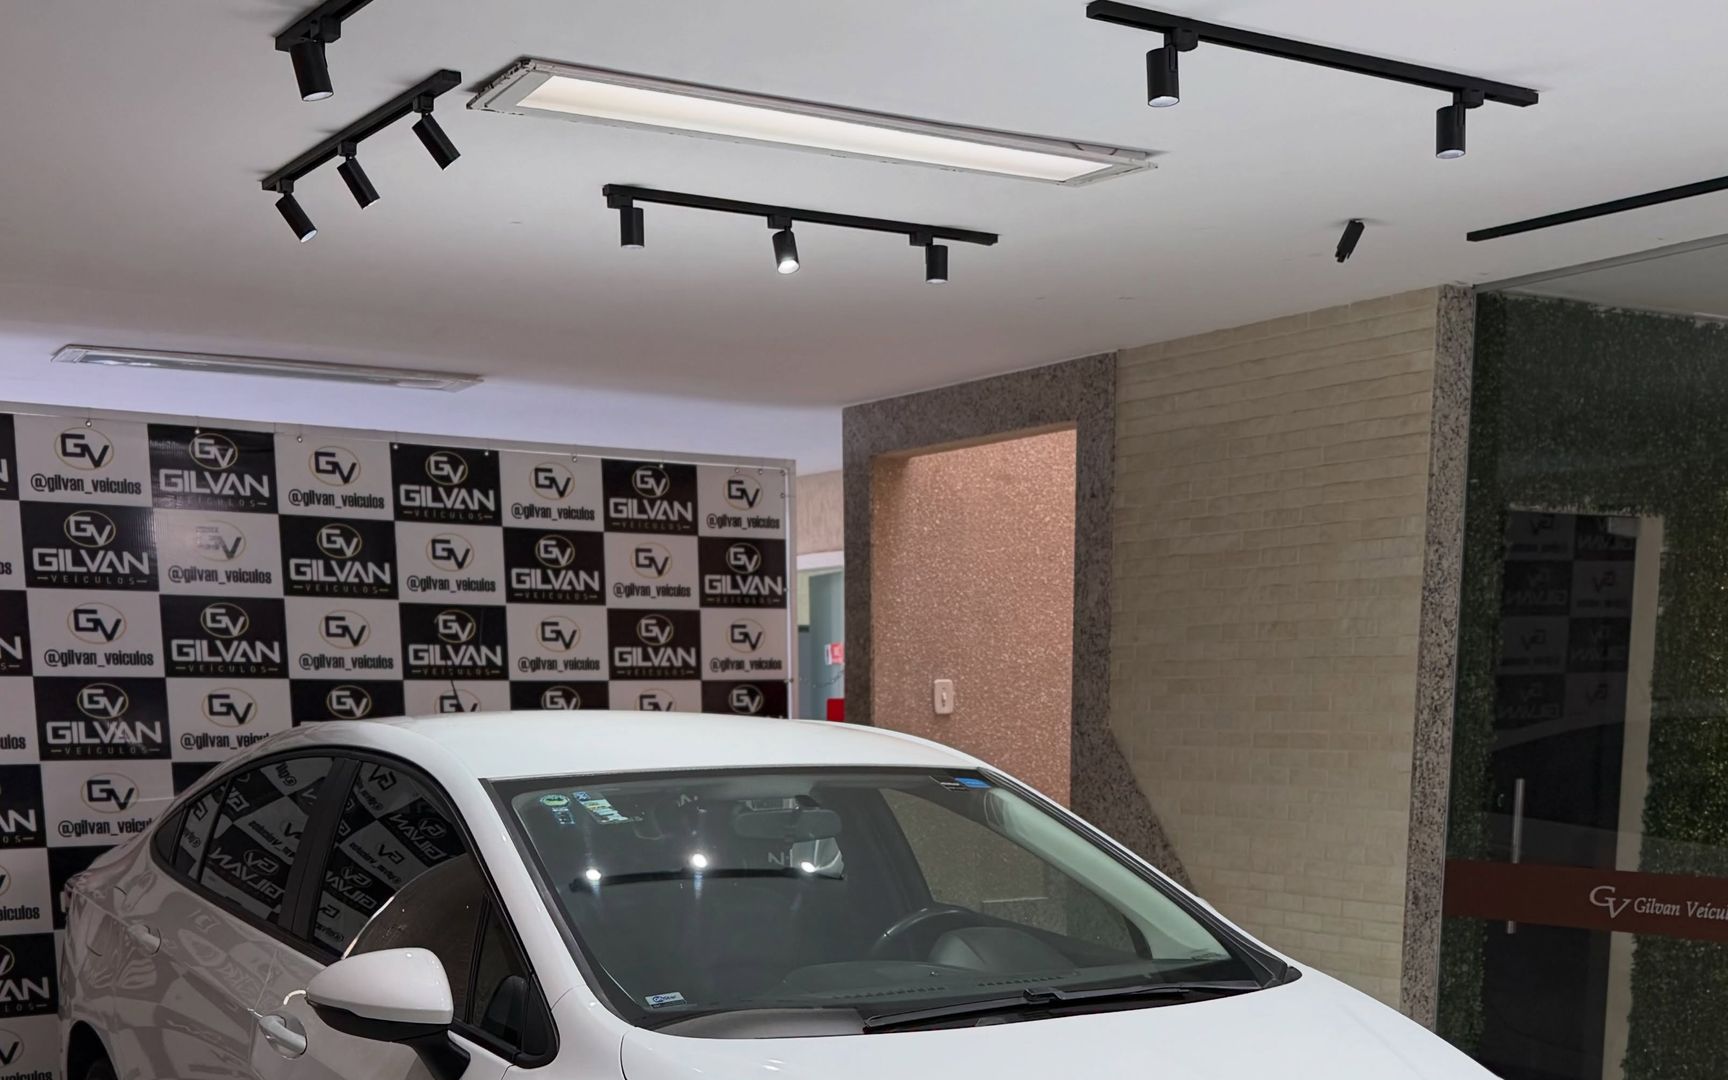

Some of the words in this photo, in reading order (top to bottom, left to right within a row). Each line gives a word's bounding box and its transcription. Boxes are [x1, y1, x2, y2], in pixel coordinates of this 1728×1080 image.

[61, 434, 109, 468] GV
[194, 438, 234, 468] GV
[314, 451, 356, 484] GV
[430, 456, 464, 484] GV
[30, 473, 142, 496] @gilvan_veiculos
[159, 468, 270, 498] GILVAN
[535, 467, 572, 498] GV
[636, 470, 666, 496] GV
[728, 480, 760, 508] GV
[288, 488, 384, 510] @gilvan_veiculos
[400, 484, 496, 512] GILVAN
[608, 497, 693, 522] GILVAN
[511, 504, 595, 522] @gilvan_veiculos
[706, 514, 780, 530] @gilvan_veiculos
[69, 516, 112, 546] GV
[321, 528, 358, 557] GV
[32, 548, 150, 574] GILVAN
[431, 539, 470, 569] GV
[539, 540, 572, 566] GV
[634, 548, 668, 577] GV
[730, 550, 758, 573] GV
[168, 566, 272, 584] @gilvan_veiculos
[290, 558, 391, 584] GILVAN
[511, 568, 600, 591] GILVAN
[407, 576, 496, 594] @gilvan_veiculos
[613, 582, 691, 598] @gilvan_veiculos
[704, 574, 783, 596] GILVAN
[73, 608, 122, 641] GV
[206, 608, 244, 636] GV
[324, 616, 366, 646] GV
[438, 615, 472, 642] GV
[540, 621, 578, 649] GV
[640, 618, 671, 644] GV
[730, 624, 762, 650] GV
[44, 648, 154, 668] @gilvan_veiculos
[171, 638, 280, 664] GILVAN
[299, 654, 394, 672] @gilvan_veiculos
[408, 644, 502, 666] GILVAN
[614, 646, 696, 668] GILVAN
[518, 656, 600, 673] @gilvan_veiculos
[710, 658, 782, 673] @gilvan_veiculos
[81, 688, 124, 717] GV
[208, 694, 253, 724] GV
[332, 690, 368, 717] GV
[732, 690, 759, 714] GV
[46, 720, 162, 744] GILVAN
[87, 780, 134, 810] GV
[1589, 885, 1632, 919] GV
[1634, 897, 1680, 916] Gilvan
